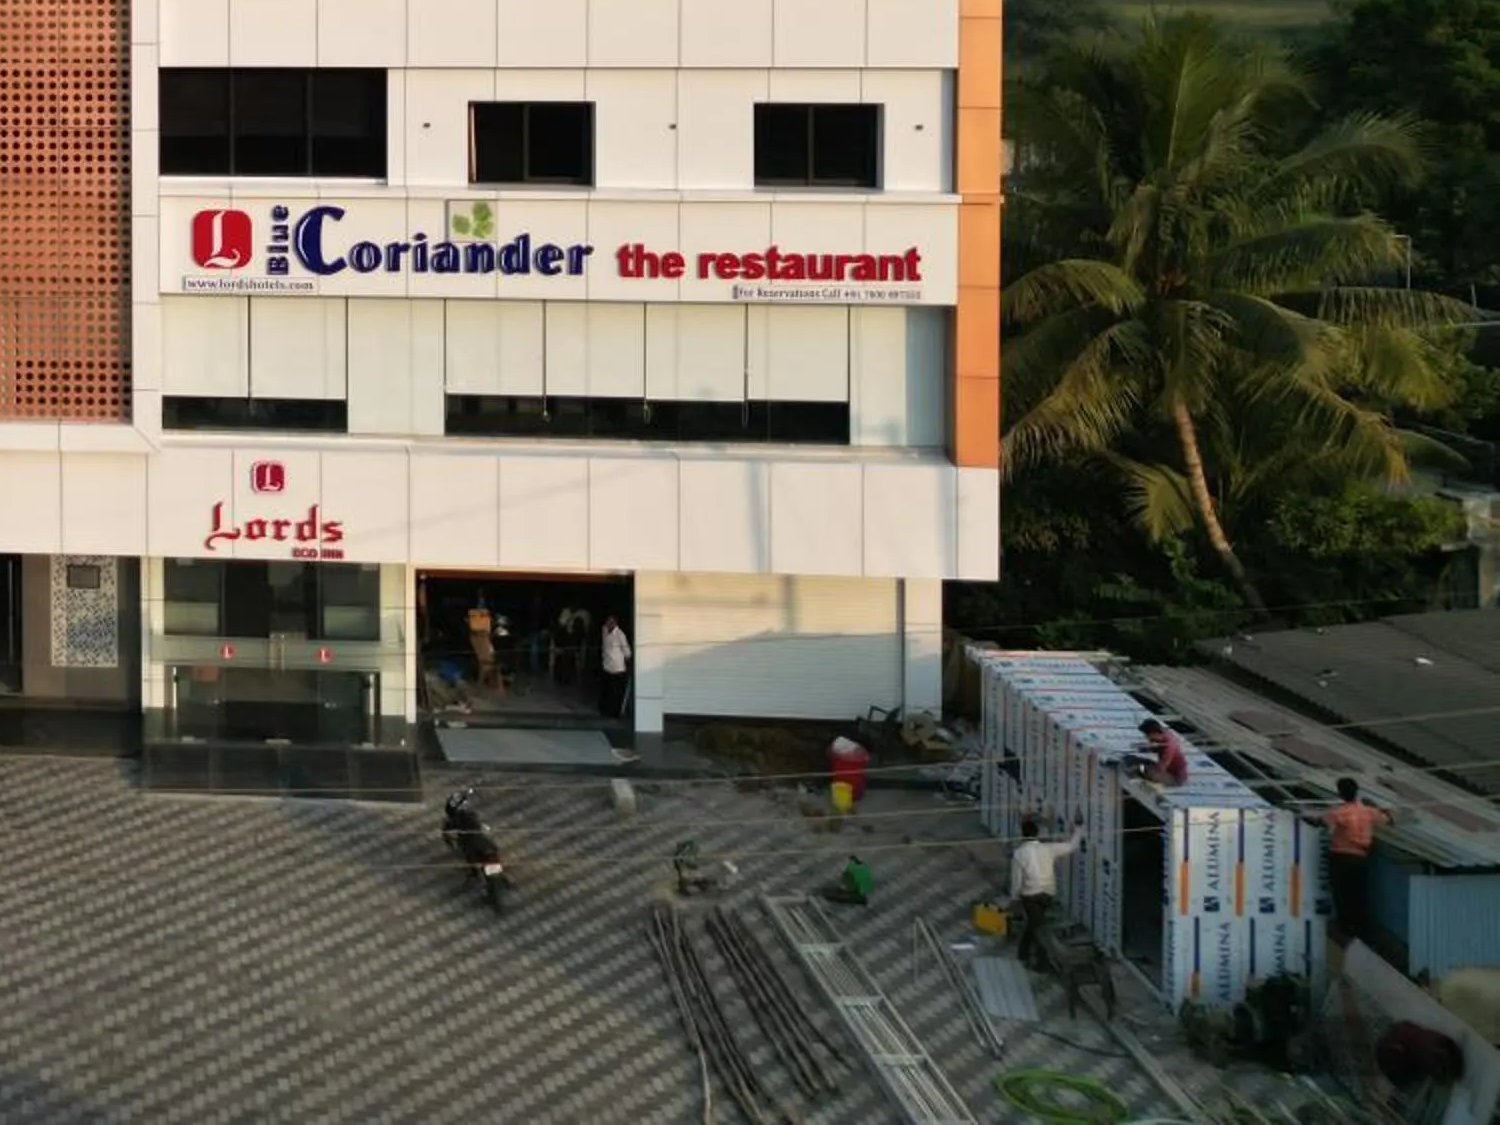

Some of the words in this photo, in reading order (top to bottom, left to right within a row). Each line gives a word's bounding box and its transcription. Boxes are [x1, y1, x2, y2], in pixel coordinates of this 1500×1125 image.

[266, 204, 290, 276] Blue
[293, 205, 595, 276] Coriander
[616, 243, 685, 279] the
[696, 245, 922, 282] restaurant
[204, 501, 344, 551] Lords
